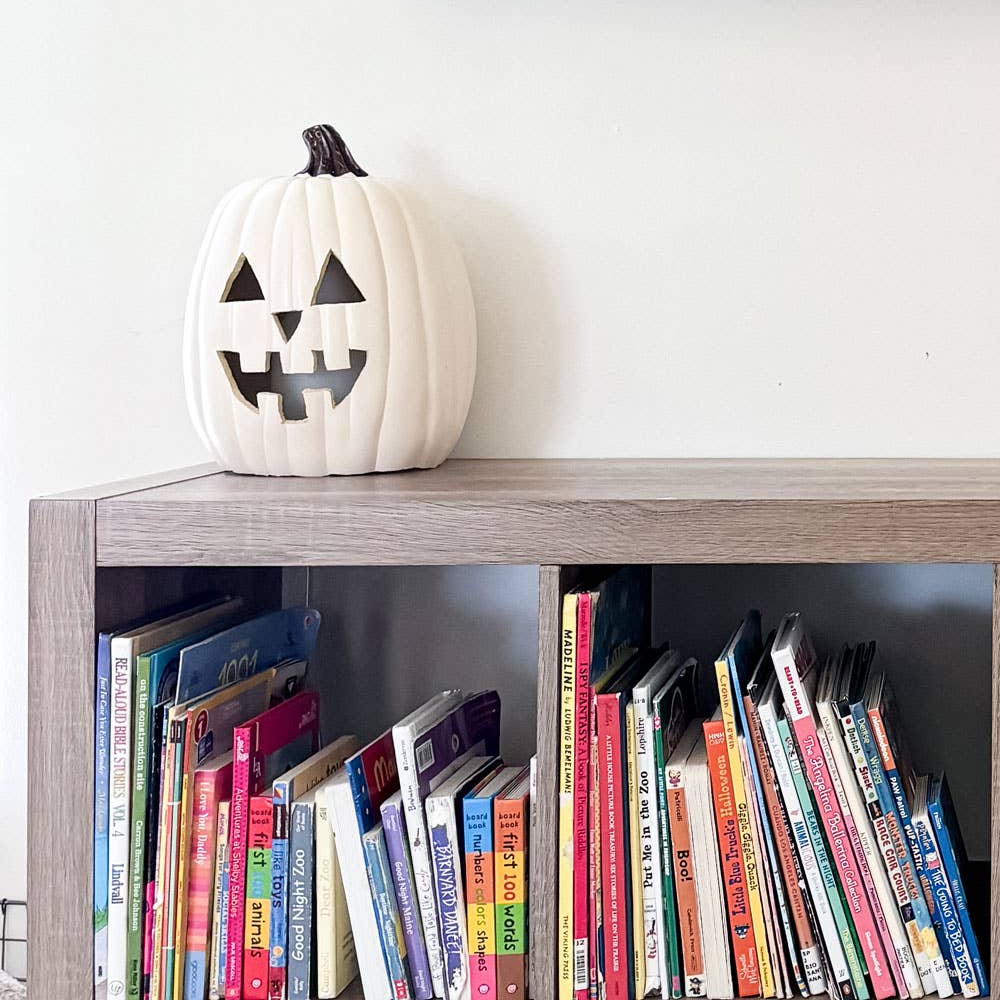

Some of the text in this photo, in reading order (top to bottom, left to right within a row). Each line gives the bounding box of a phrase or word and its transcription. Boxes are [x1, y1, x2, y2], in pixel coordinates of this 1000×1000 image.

[114, 657, 128, 723] READ-ALOUD
[564, 629, 573, 741] MADELINE LUDWIG
[719, 674, 736, 751] Cronin Lewin
[113, 726, 127, 754] BIBLE
[136, 690, 147, 791] the construction site
[577, 669, 588, 826] SPY Picture
[637, 717, 647, 754] Lopshire
[871, 715, 890, 762] nickelodeon
[113, 757, 126, 798] STORIES
[859, 766, 873, 790] Slack
[889, 776, 907, 819] PAW Patrol
[195, 788, 209, 865] Love Daddy
[230, 788, 244, 917] Adventures Shelby Stables
[639, 771, 653, 888] Put Me in the Zoo
[718, 754, 746, 916] Little Blue Halloween
[737, 803, 757, 892] Giggle, Giggle, Quack
[772, 805, 803, 919] CUANDO LOS CANTAN
[804, 736, 815, 756] The
[810, 757, 833, 813] Angelina
[828, 813, 850, 868] Ballerina
[844, 870, 863, 913] Collection
[807, 810, 819, 836] BEARS
[816, 847, 827, 863] THE
[822, 864, 834, 889] NIGHT
[874, 819, 908, 905] RACE CAR COUNT
[885, 811, 907, 858] MONSTER
[111, 864, 125, 904] Lindvall
[251, 832, 268, 958] first animals
[272, 875, 285, 909] toys
[319, 859, 330, 882] Zoo
[394, 861, 414, 935] Good Night Maine
[437, 845, 456, 905] BARNYARD
[473, 834, 489, 972] numbers colors shapes
[503, 833, 518, 951] first 100 words
[677, 849, 692, 882] Boo!
[292, 849, 307, 961] Good Night Zoo
[931, 869, 973, 982] THE GOING TO BED BOOK
